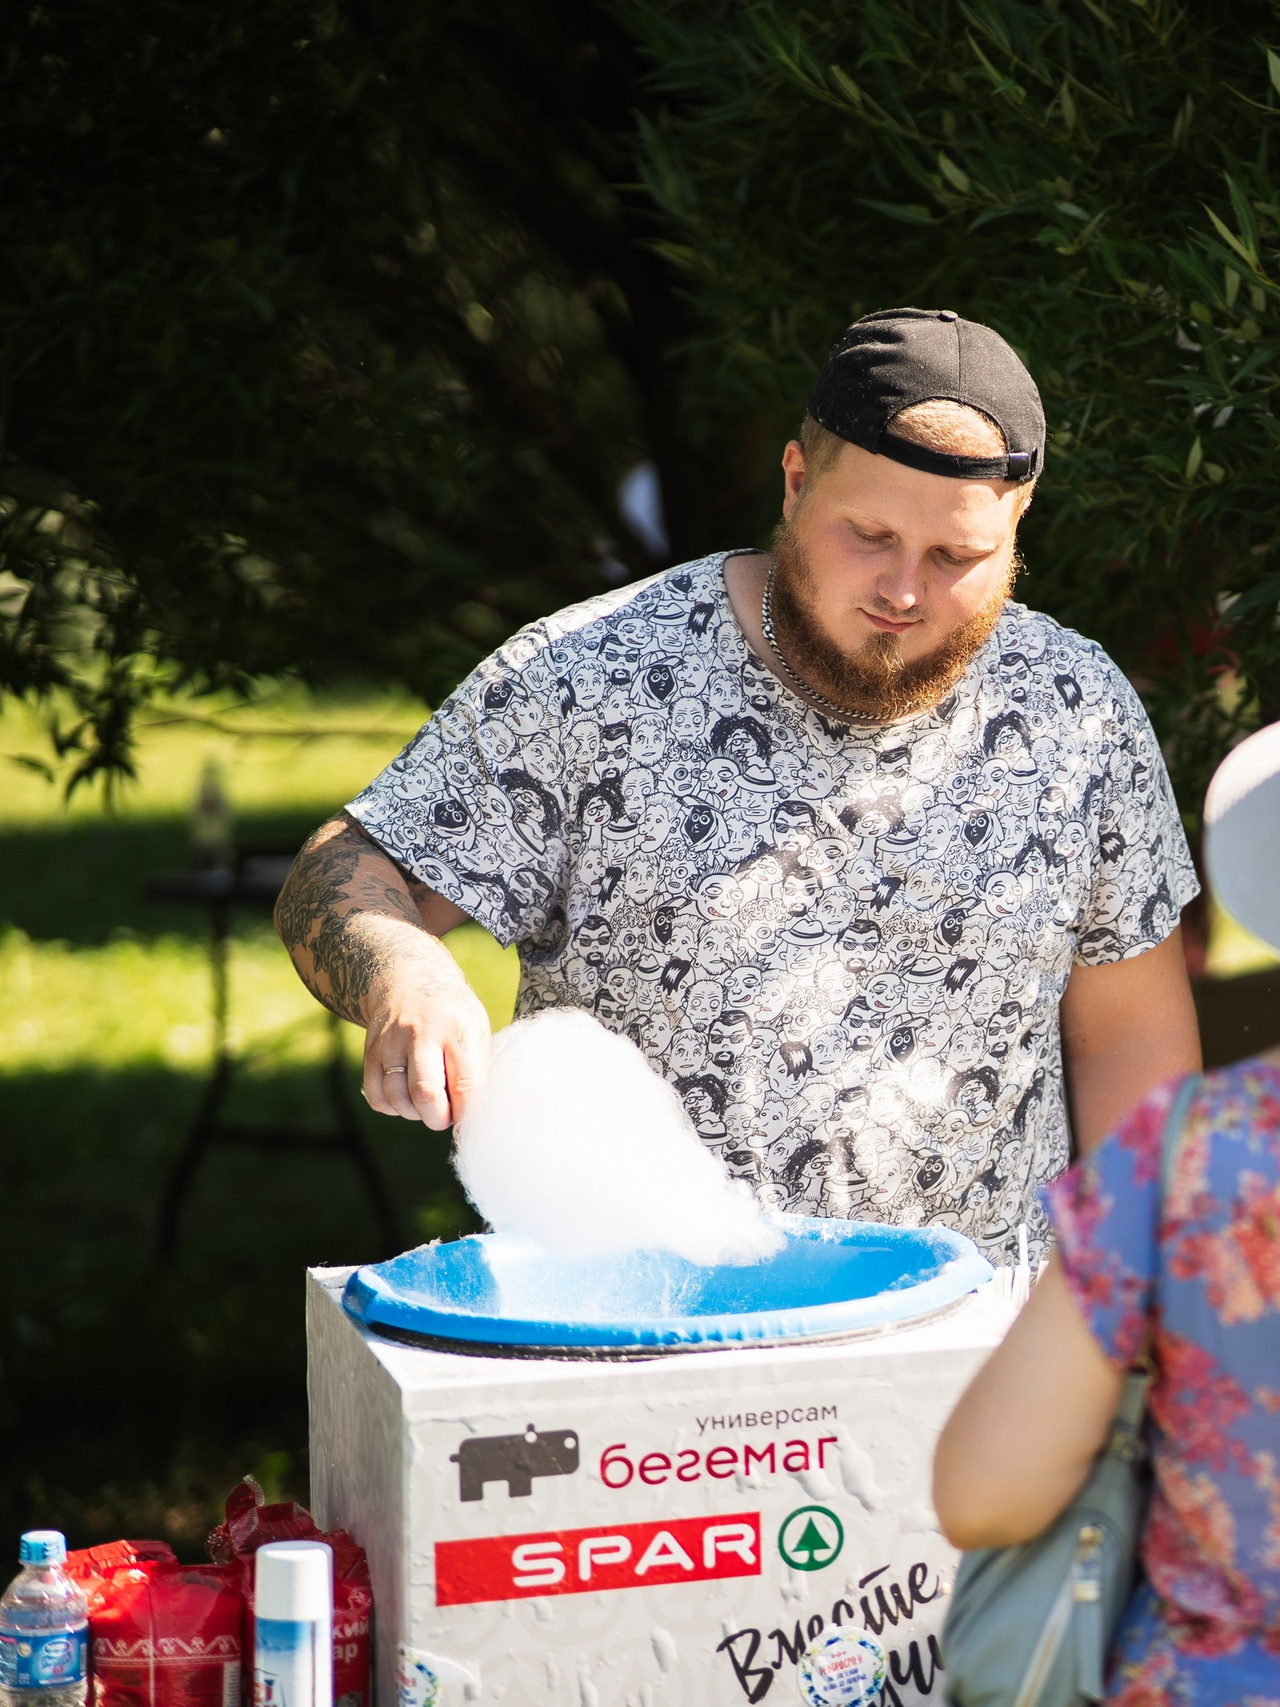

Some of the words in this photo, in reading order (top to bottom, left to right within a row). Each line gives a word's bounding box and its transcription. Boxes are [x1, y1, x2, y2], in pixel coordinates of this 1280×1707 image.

[695, 1405, 839, 1436] универсам
[599, 1436, 839, 1489] бегемаг
[512, 1523, 757, 1588] SPAR
